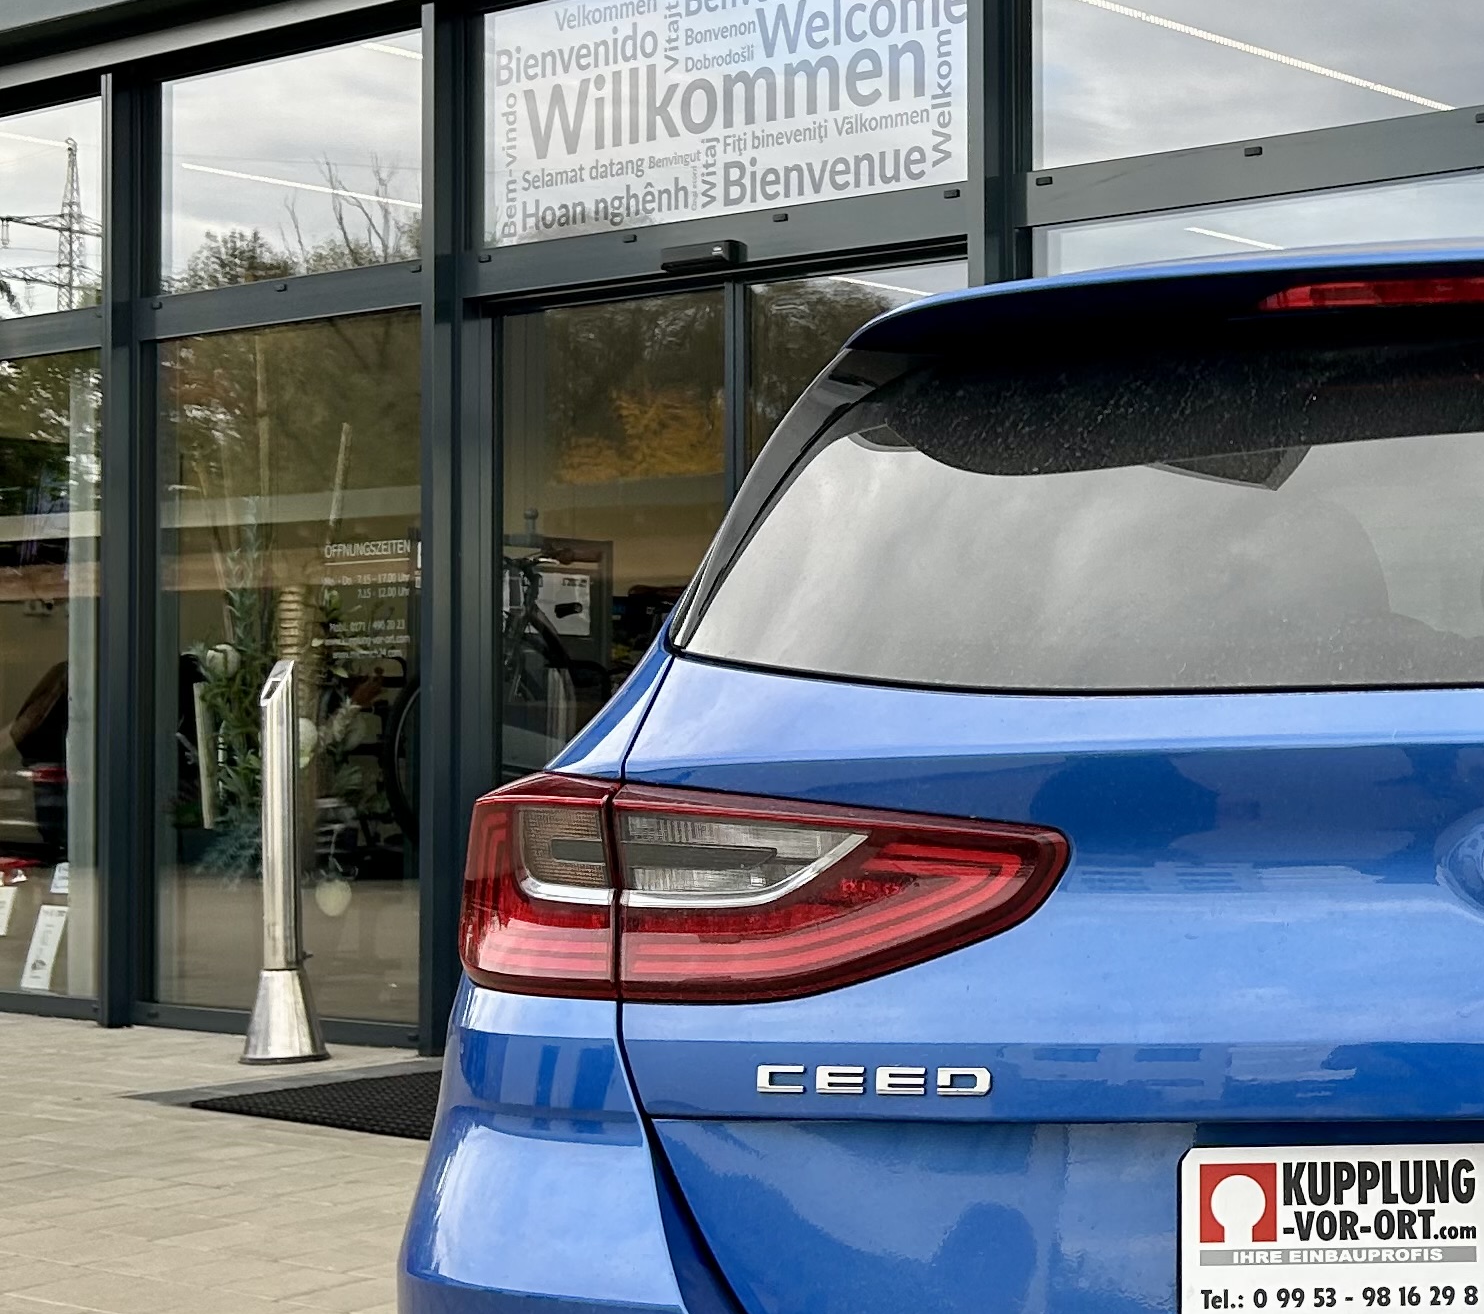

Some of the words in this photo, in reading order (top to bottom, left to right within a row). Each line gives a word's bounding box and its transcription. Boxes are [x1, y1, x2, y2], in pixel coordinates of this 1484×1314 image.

[685, 19, 756, 46] Bonvenon
[496, 23, 657, 86] Bienvenido
[685, 45, 754, 73] Dobrodošli
[523, 38, 925, 160] Willkommen
[930, 29, 952, 168] Welkom
[835, 108, 930, 137] Välkommen
[501, 92, 517, 239] Bem-vindo
[522, 165, 586, 192] Selamat
[589, 156, 644, 184] datang
[648, 150, 701, 169] Benvingut
[701, 137, 720, 209] Witaj
[723, 145, 926, 208] Bienvenue
[522, 196, 586, 232] Hoan
[594, 176, 689, 227] nghênh
[757, 1064, 992, 1096] CEED
[1283, 1159, 1476, 1206] KUPPLUNG
[1283, 1209, 1477, 1241] -VOR-ORT.com
[1233, 1250, 1282, 1264] IHRE
[1289, 1248, 1443, 1264] EINBAUPROFIS
[1201, 1289, 1244, 1309] Tel.:
[1253, 1288, 1268, 1308] 0
[1276, 1288, 1305, 1308] 99
[1313, 1287, 1337, 1308] 53
[1362, 1286, 1391, 1307] 98
[1399, 1286, 1421, 1307] 16
[1430, 1285, 1455, 1306] 29
[1464, 1285, 1479, 1306] 8
